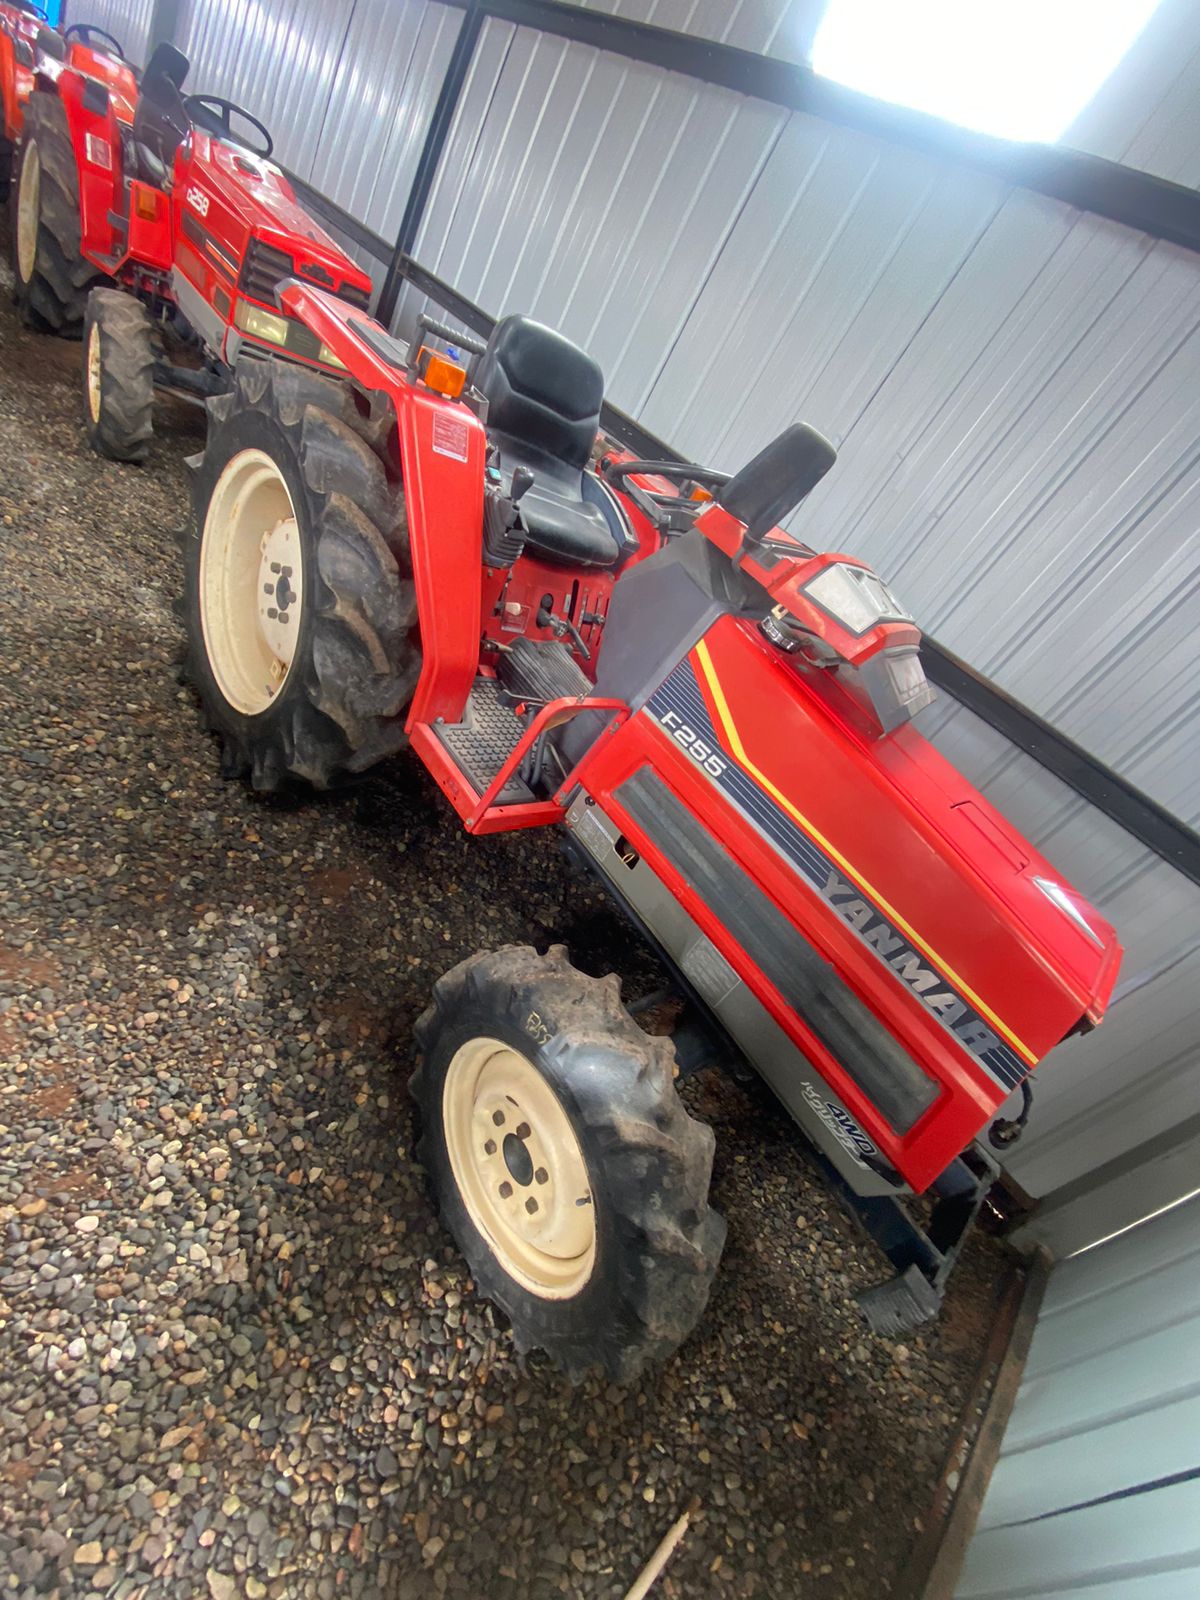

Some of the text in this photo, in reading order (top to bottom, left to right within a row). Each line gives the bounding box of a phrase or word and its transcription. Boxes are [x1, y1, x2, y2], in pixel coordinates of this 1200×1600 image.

[660, 710, 727, 778] F255
[821, 869, 1001, 1055] YANMAR
[825, 1101, 877, 1155] 4WD
